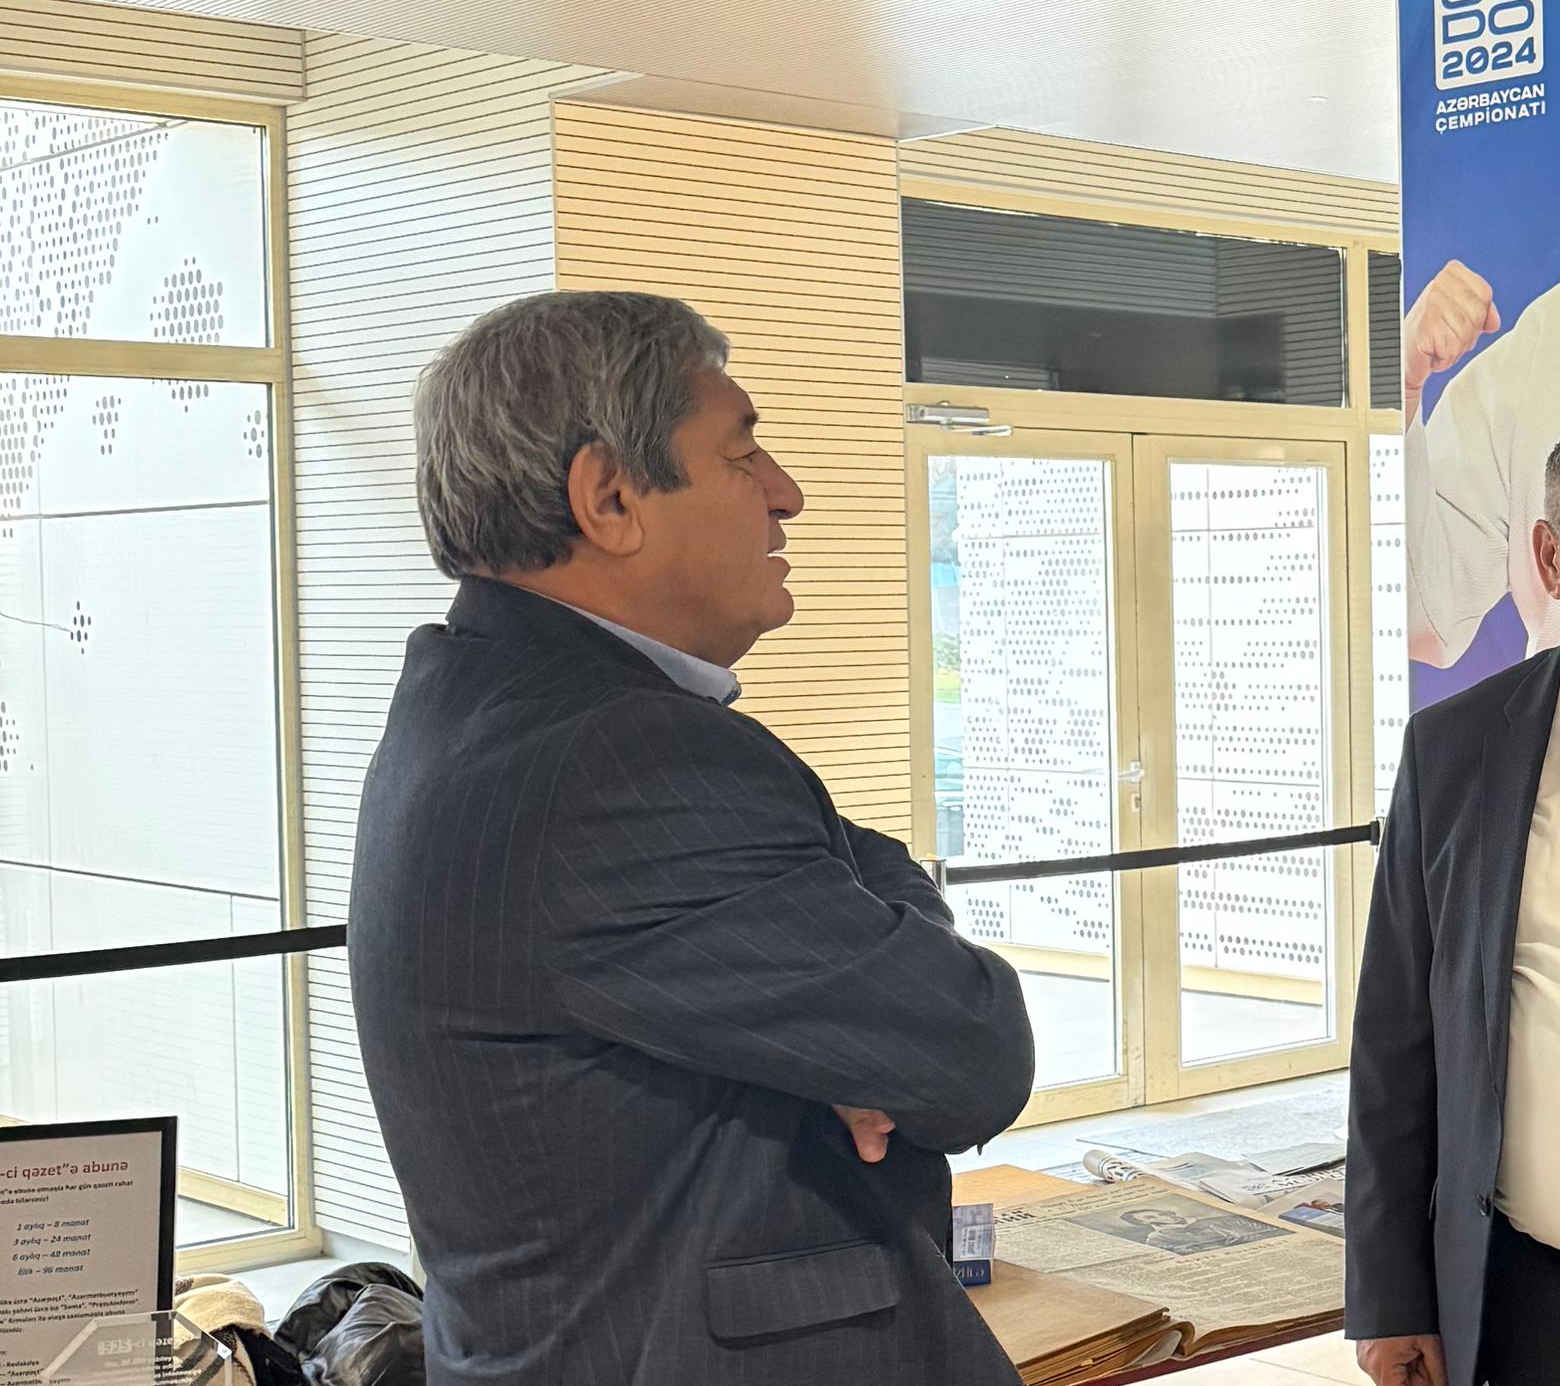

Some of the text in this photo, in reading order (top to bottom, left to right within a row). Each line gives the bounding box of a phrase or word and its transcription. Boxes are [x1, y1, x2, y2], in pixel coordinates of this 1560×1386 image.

[1442, 36, 1537, 80] 2024
[1436, 83, 1545, 115] AZƏRBAYCAN
[1435, 100, 1546, 135] ÇEMPİONATI
[83, 1161, 128, 1174] abunə
